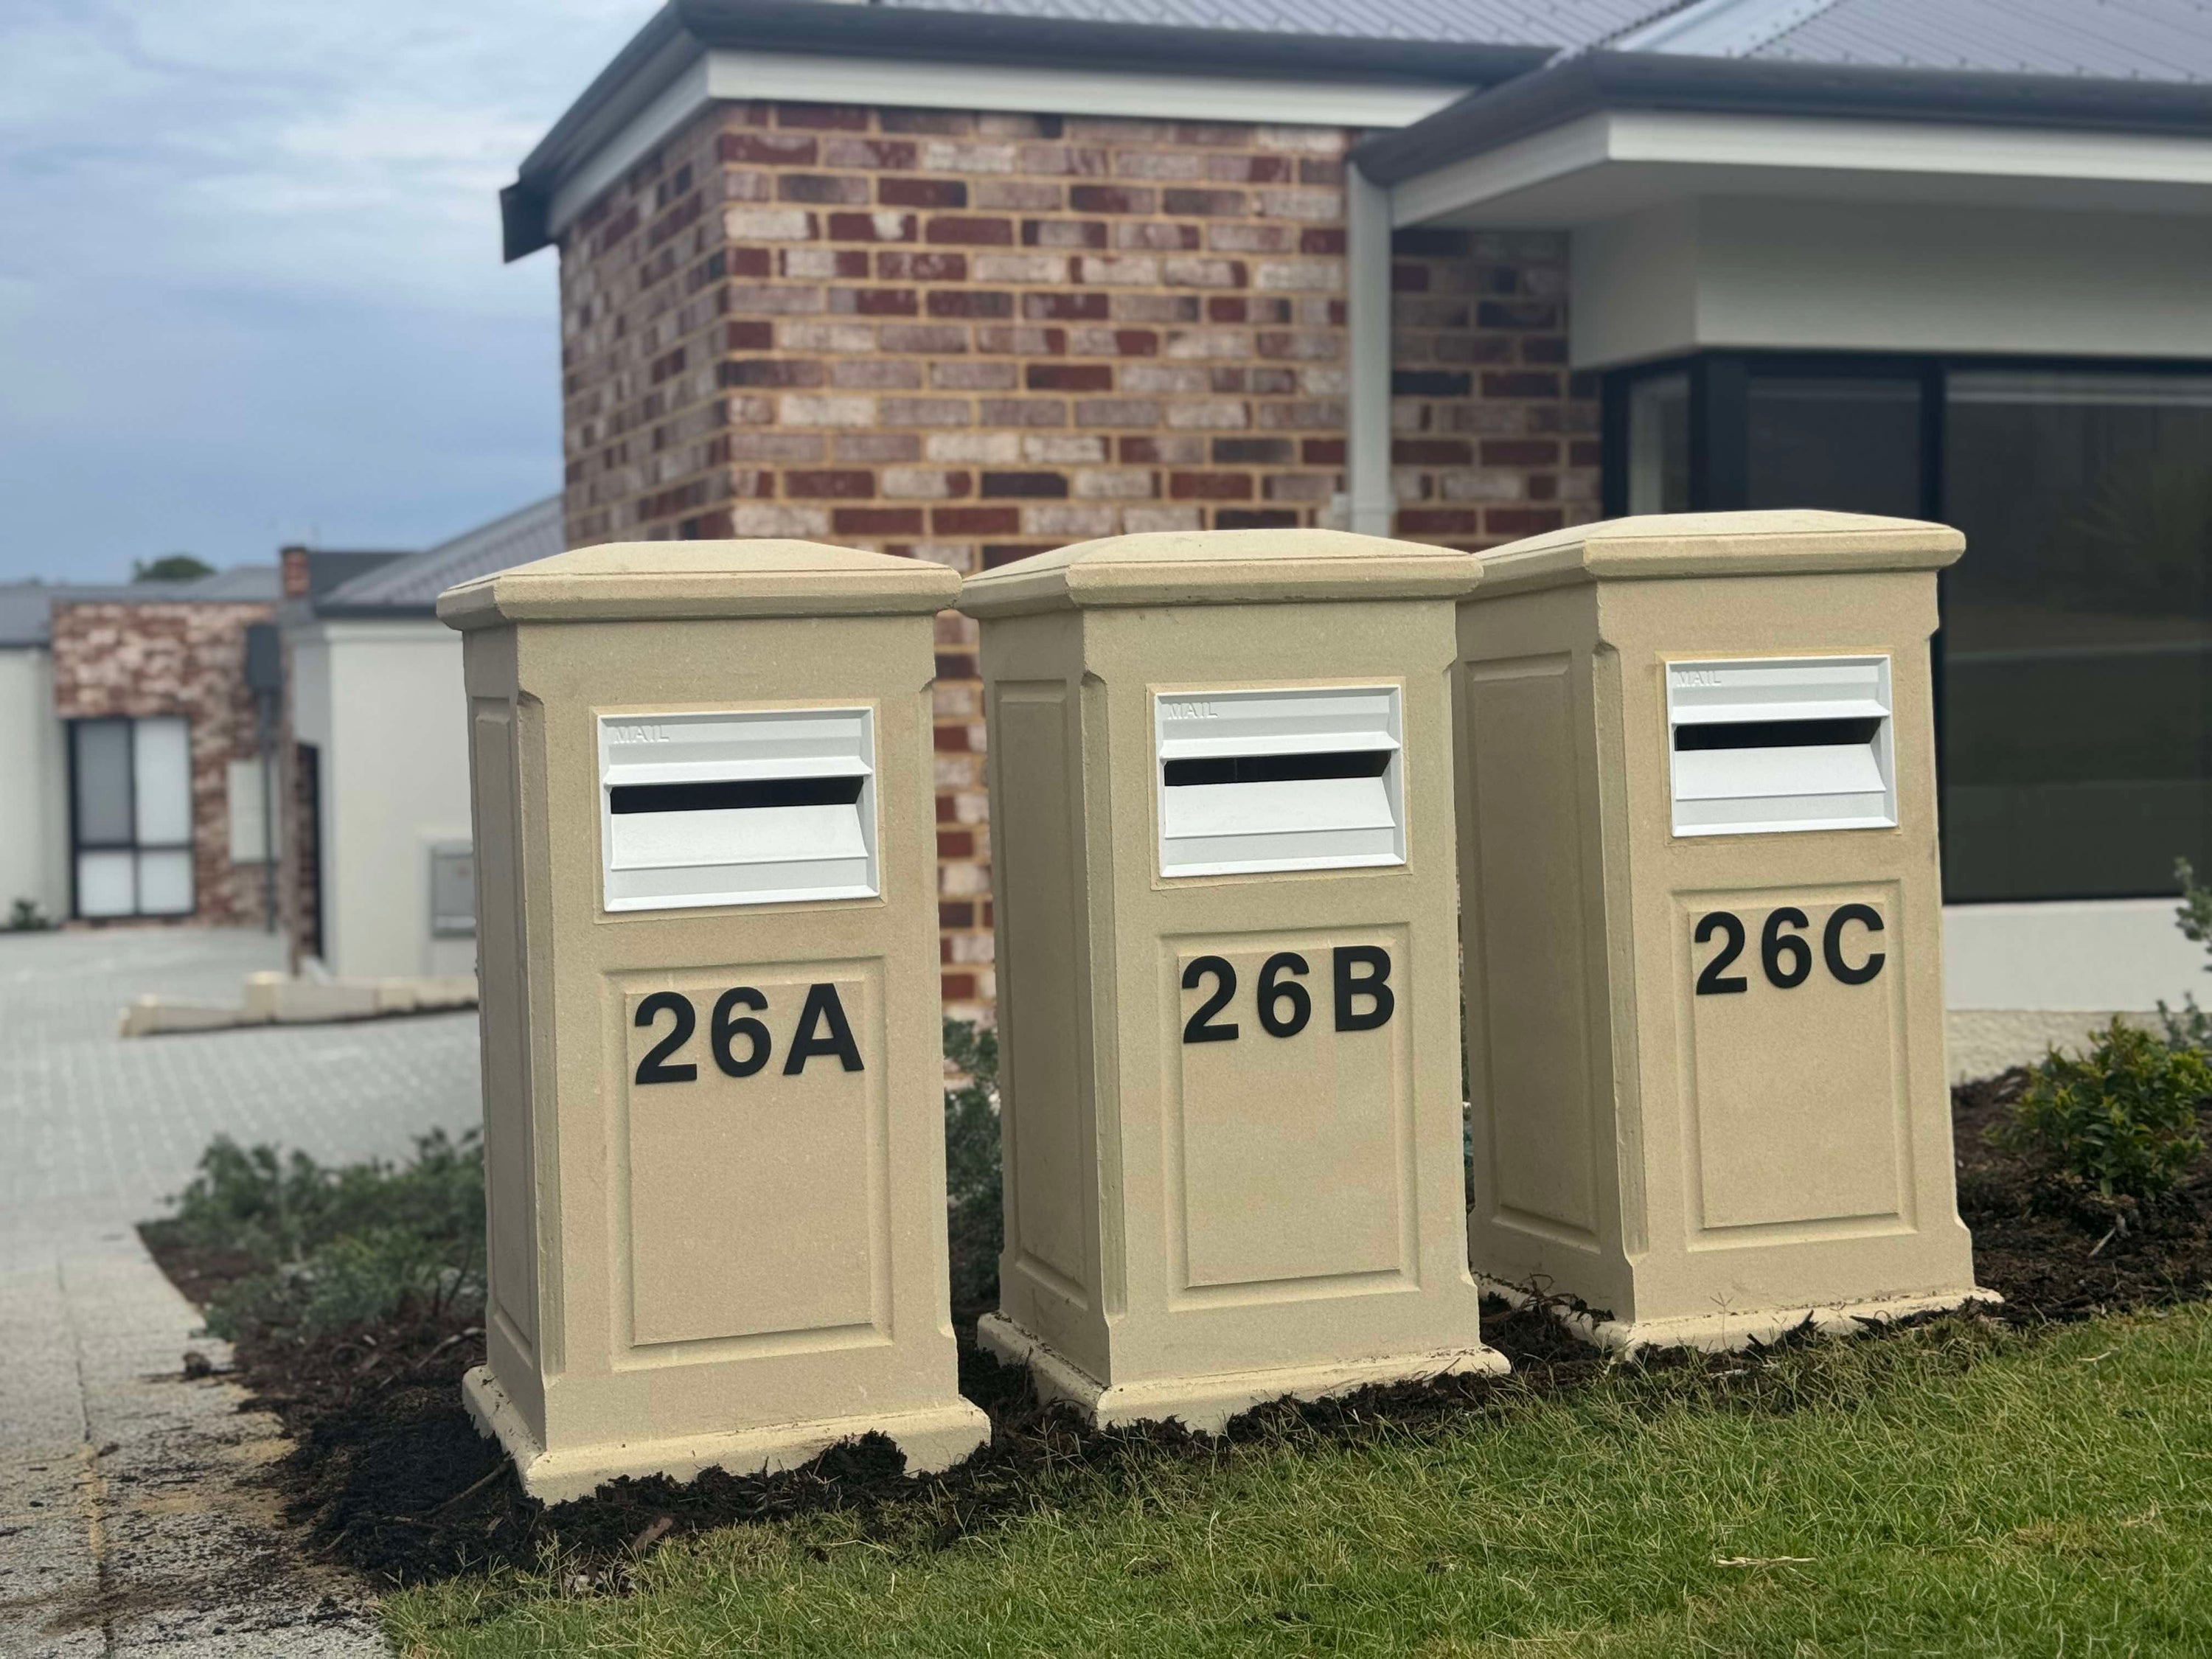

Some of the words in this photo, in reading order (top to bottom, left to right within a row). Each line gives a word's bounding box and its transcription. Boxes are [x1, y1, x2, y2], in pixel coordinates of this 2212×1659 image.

[1676, 669, 1722, 687] MAIL
[613, 725, 669, 744] MAIL
[1167, 702, 1218, 720] MAIL
[1694, 903, 1885, 996] 26C
[1181, 945, 1395, 1044] 26B
[634, 983, 865, 1085] 26A
